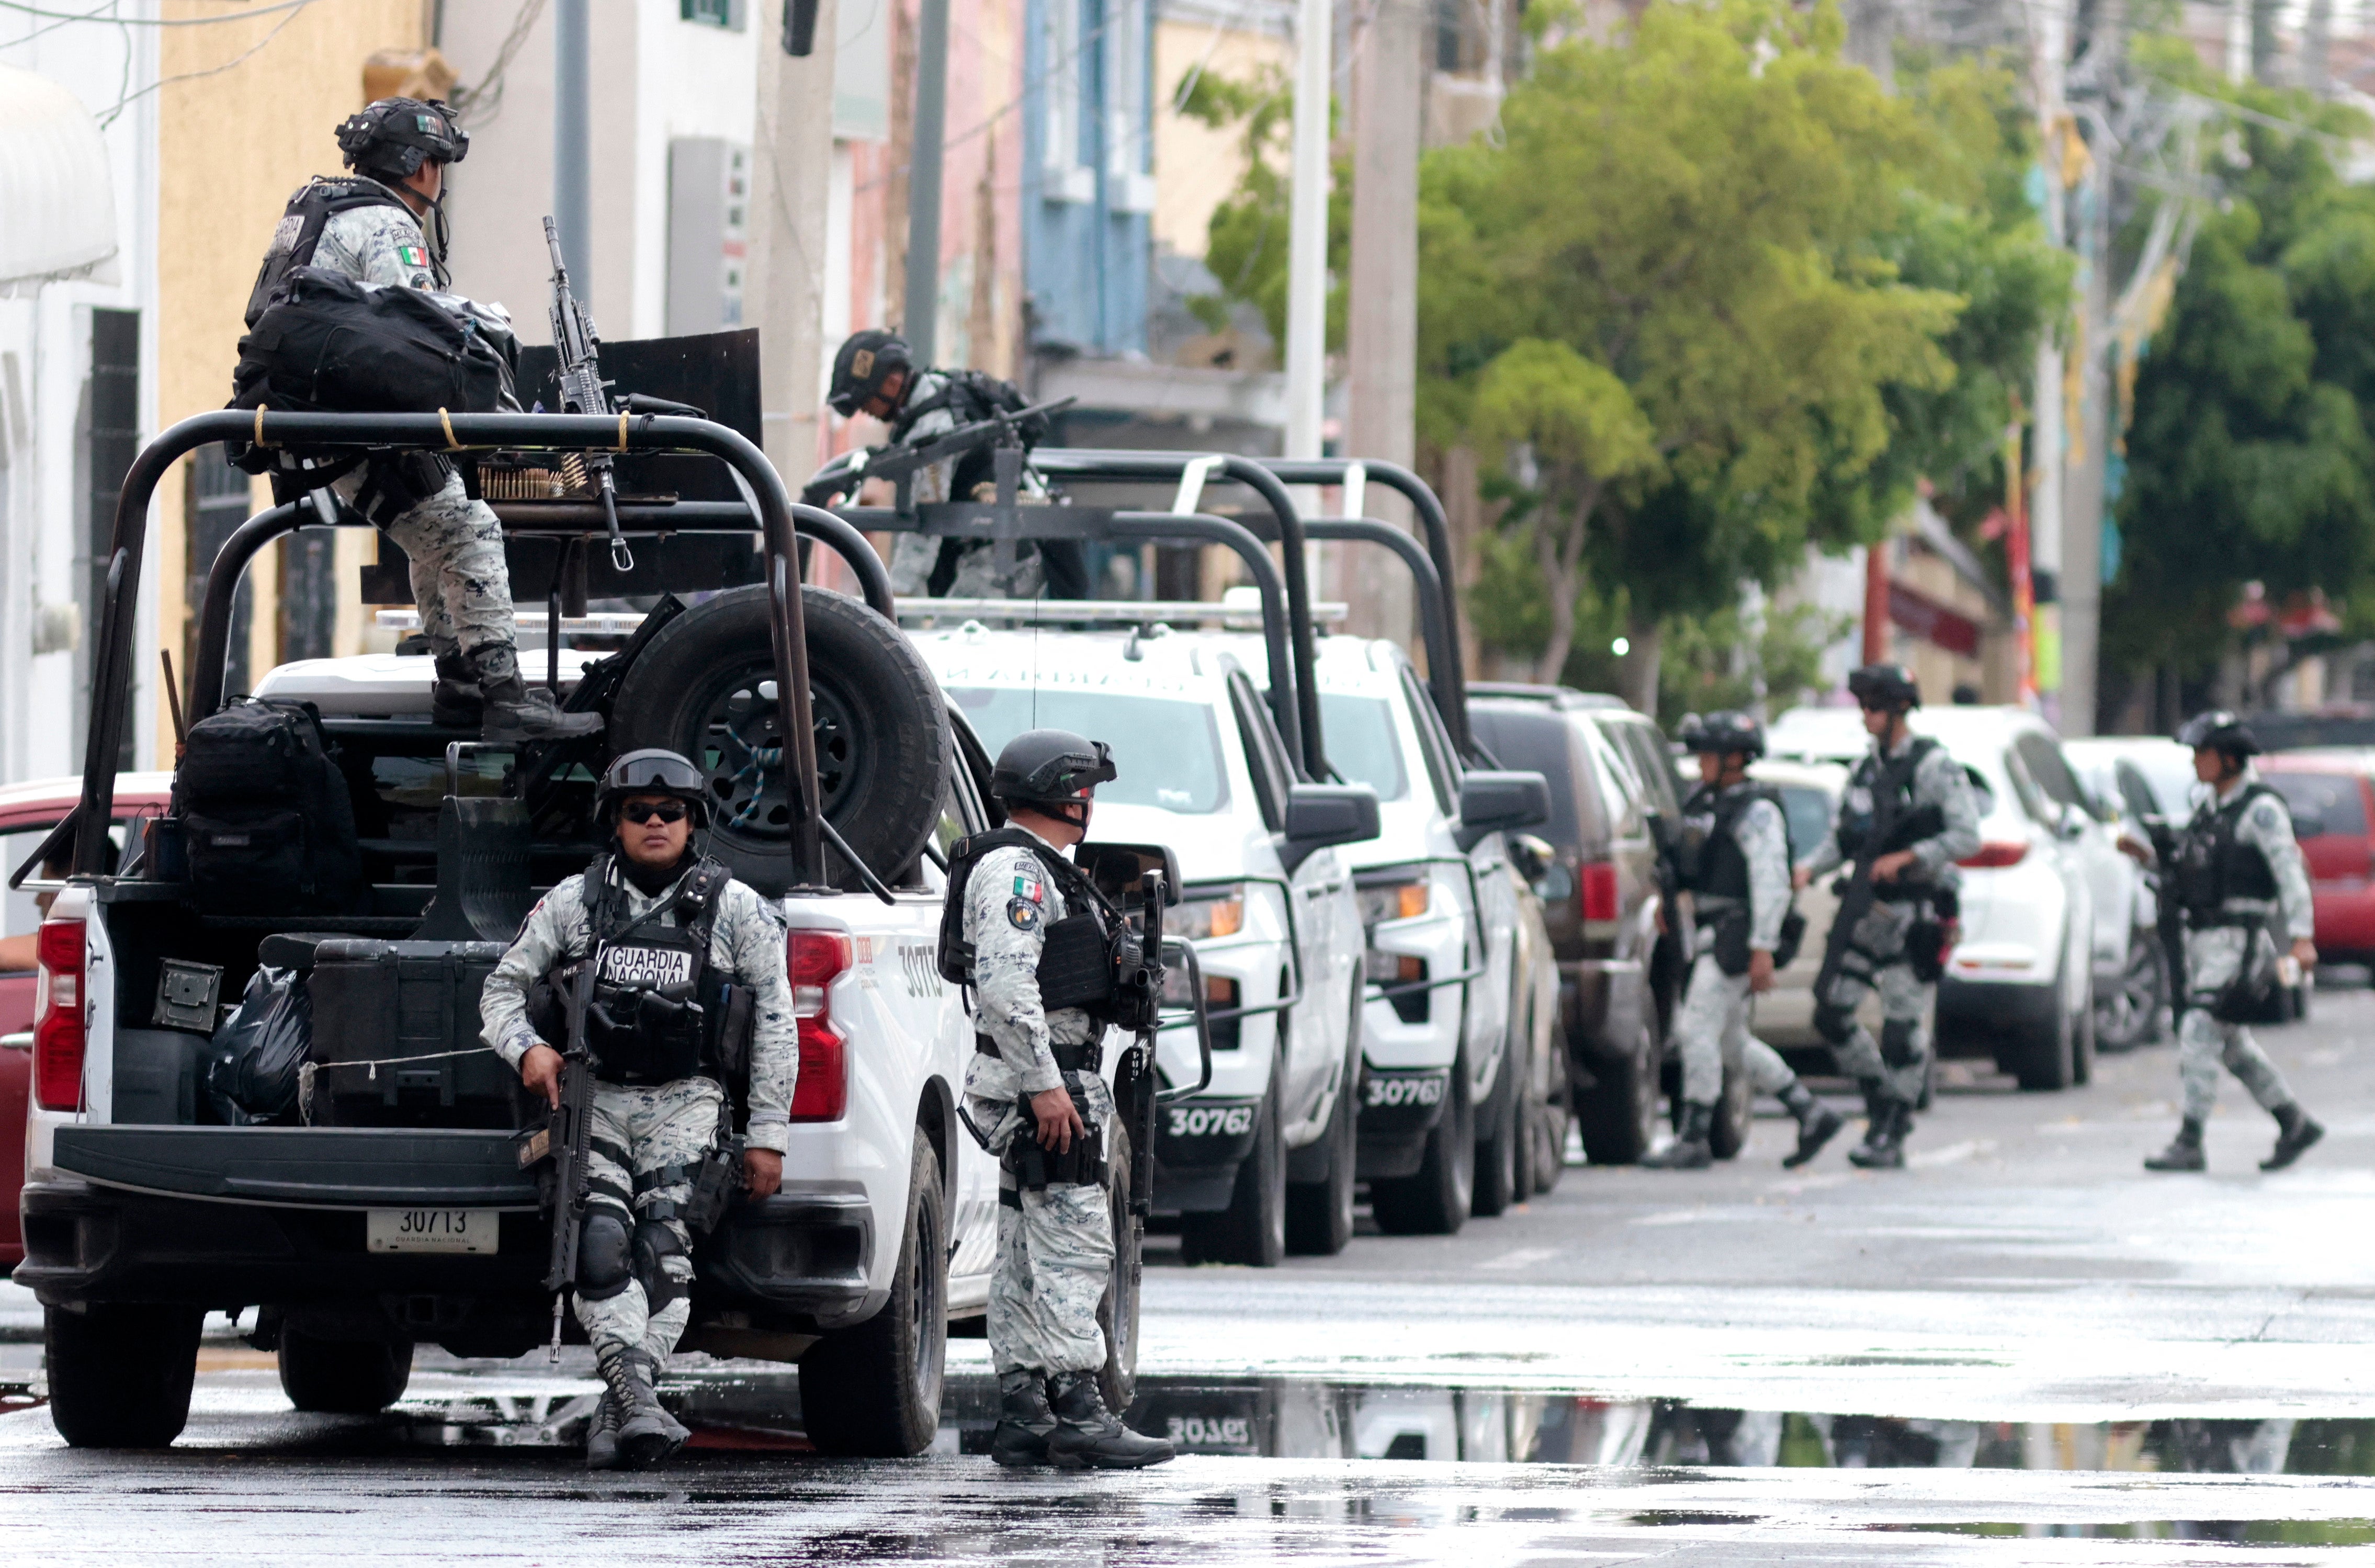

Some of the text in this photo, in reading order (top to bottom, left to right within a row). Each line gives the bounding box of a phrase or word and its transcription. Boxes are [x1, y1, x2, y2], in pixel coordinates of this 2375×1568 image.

[613, 947, 683, 972] GUARDIA
[898, 945, 943, 998] 30713
[1169, 1106, 1252, 1136] 30762
